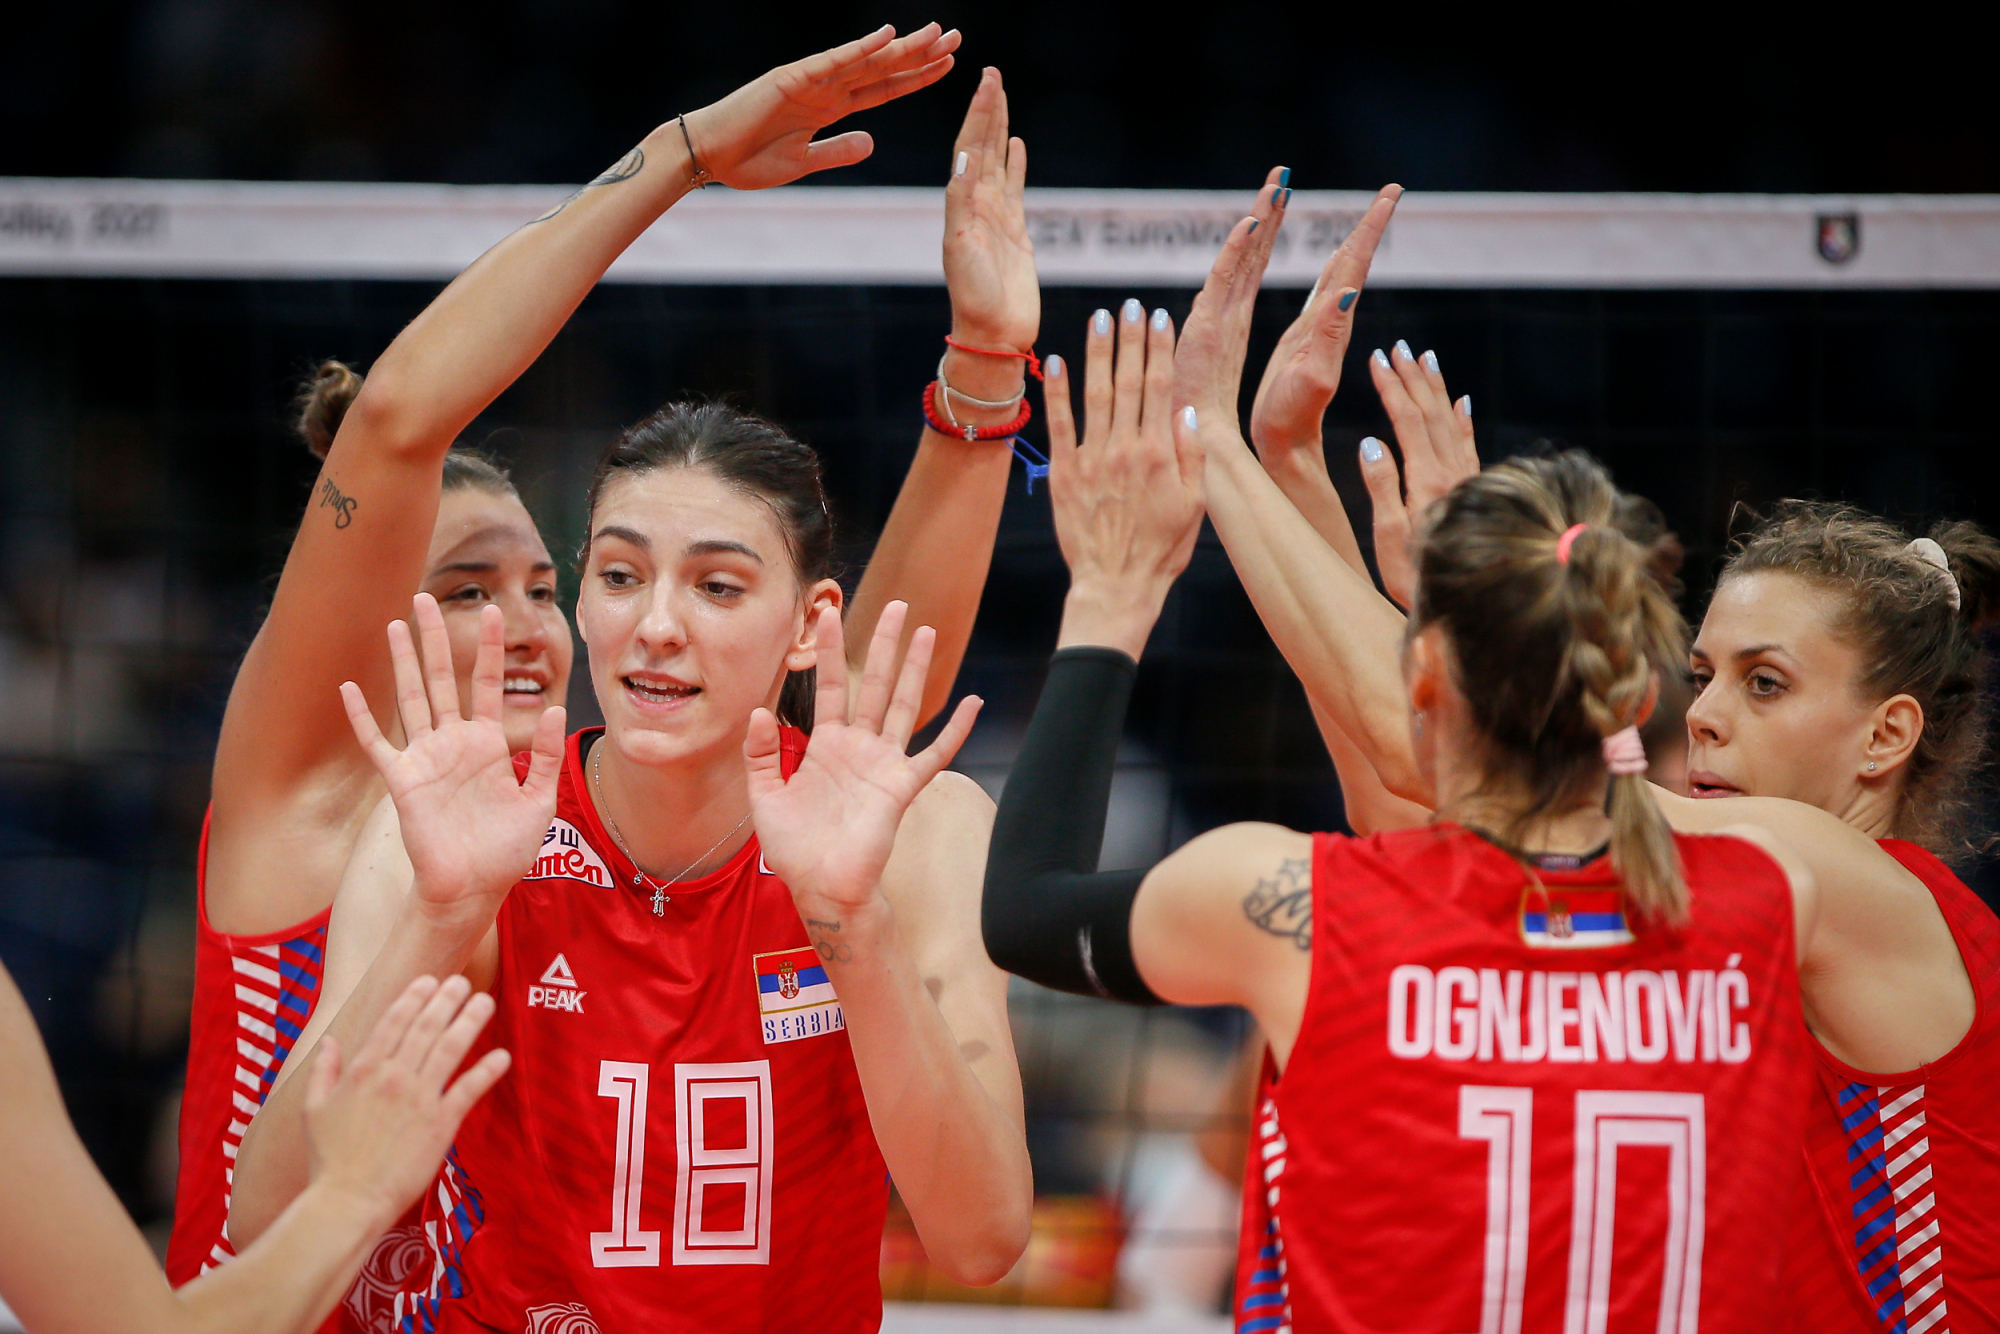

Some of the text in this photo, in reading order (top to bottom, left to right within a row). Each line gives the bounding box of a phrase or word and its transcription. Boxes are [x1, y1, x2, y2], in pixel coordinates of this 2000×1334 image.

[527, 985, 588, 1014] PEAK
[765, 1007, 844, 1041] SERBIA
[1387, 953, 1752, 1064] OGNJENOVIĆ
[590, 1059, 774, 1268] 18
[1458, 1085, 1706, 1334] 10
